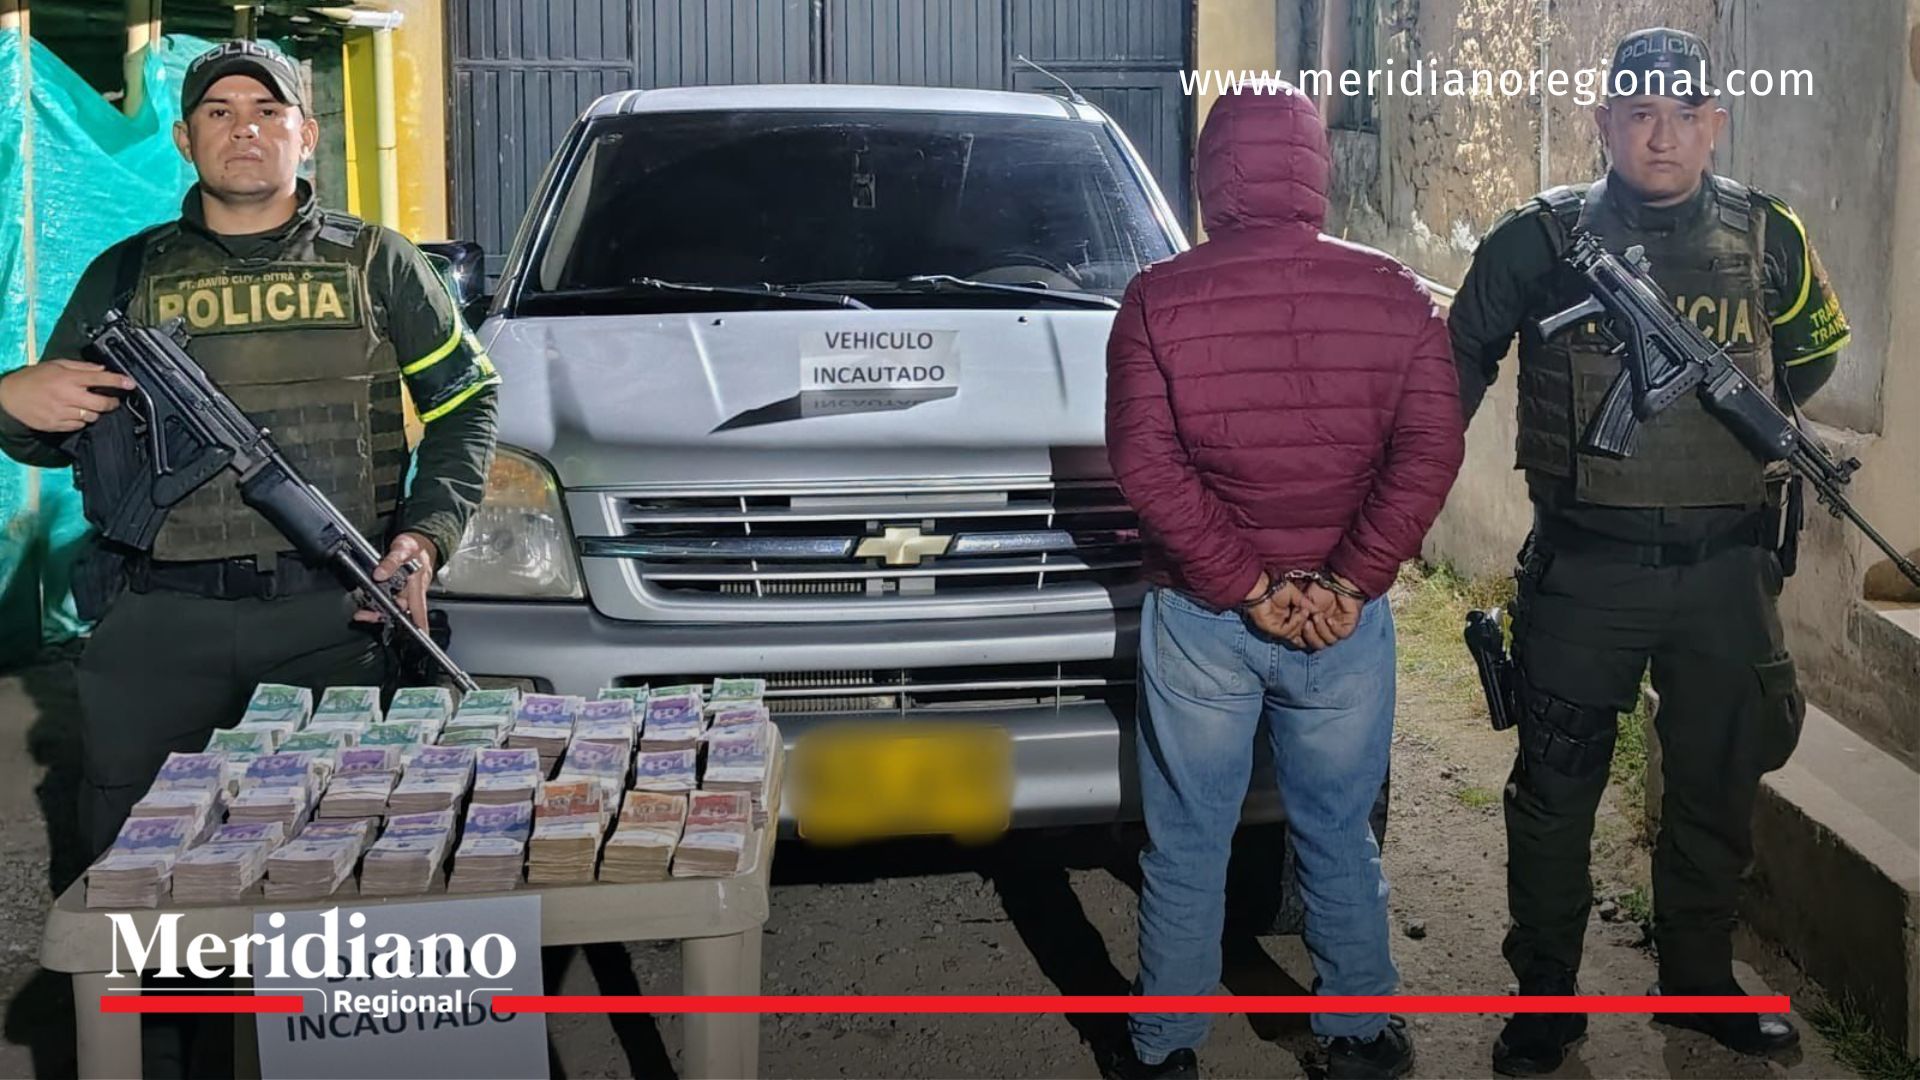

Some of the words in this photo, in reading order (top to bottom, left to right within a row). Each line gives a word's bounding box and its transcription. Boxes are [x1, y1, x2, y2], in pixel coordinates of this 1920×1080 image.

[192, 40, 291, 73] POLICIA
[1621, 34, 1702, 64] POLICIA
[159, 283, 346, 328] POLICIA
[825, 331, 933, 350] VEHICULO
[813, 365, 945, 384] INCAUTADO
